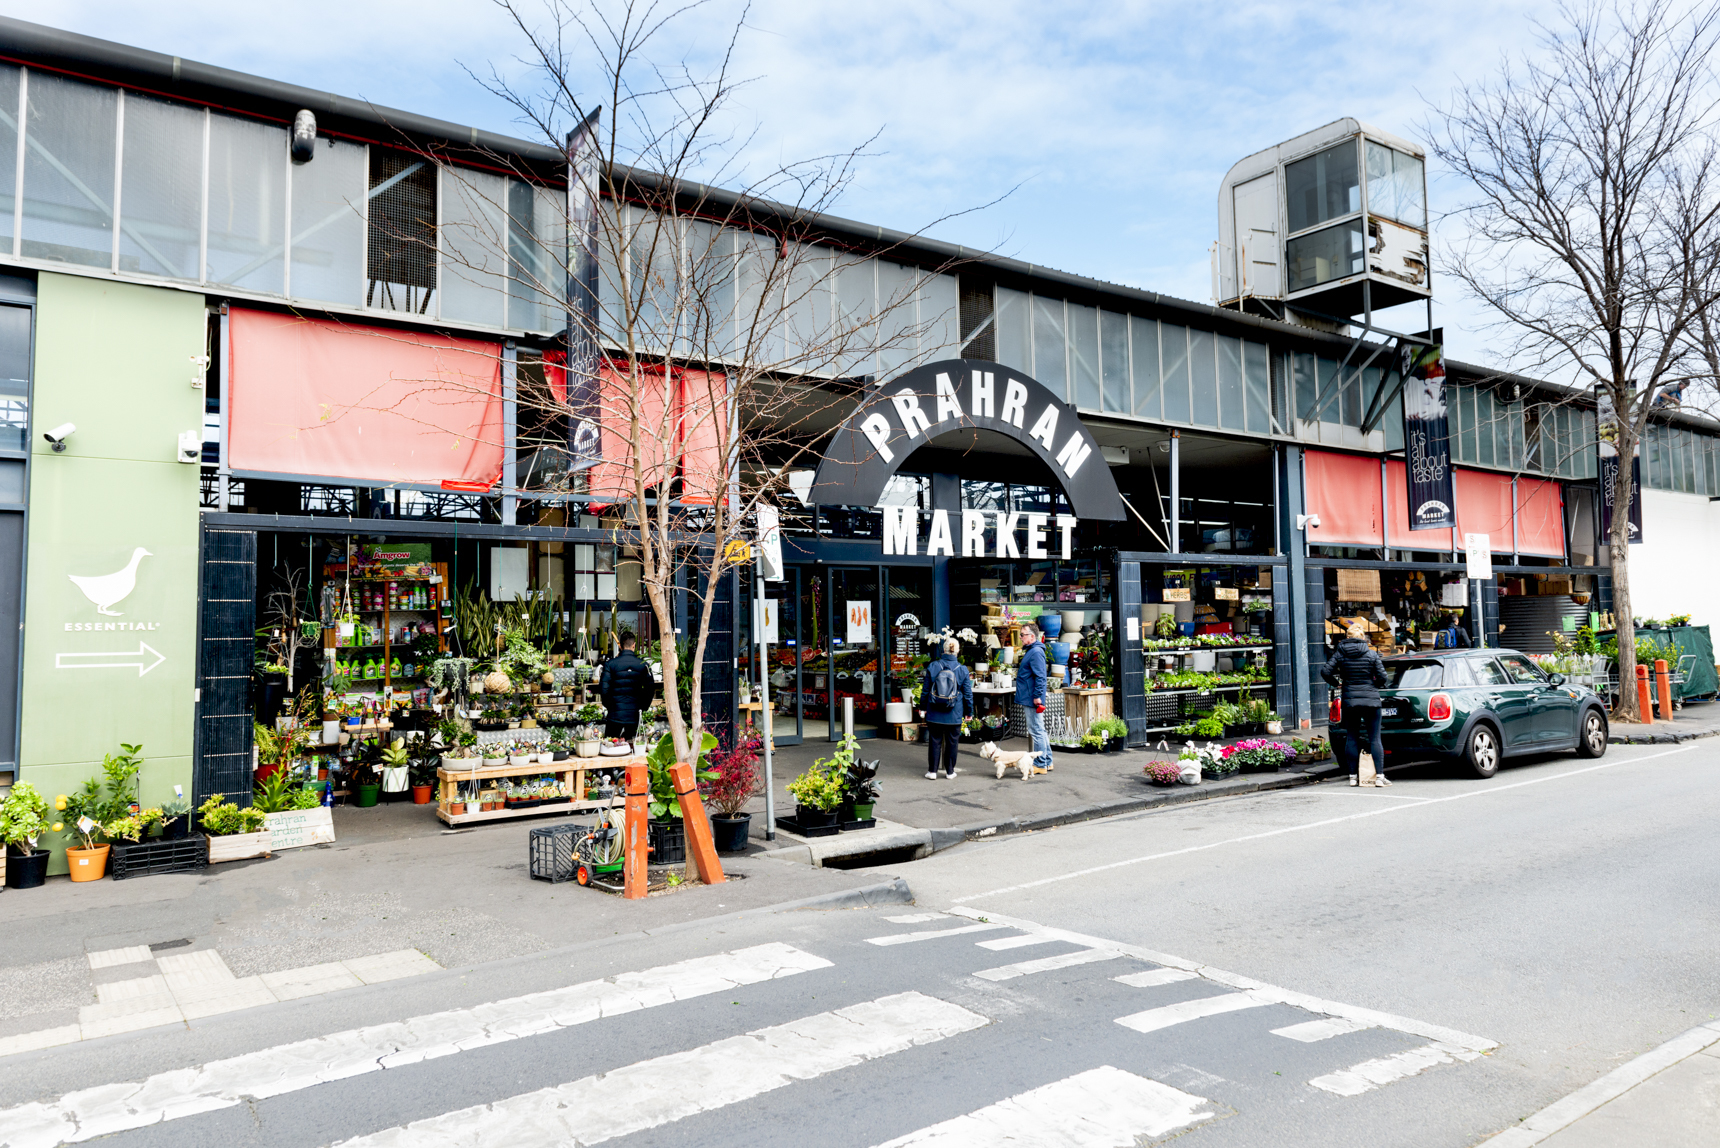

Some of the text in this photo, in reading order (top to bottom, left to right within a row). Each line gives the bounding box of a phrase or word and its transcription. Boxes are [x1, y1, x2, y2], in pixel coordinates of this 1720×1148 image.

[860, 370, 1092, 479] PRAHRAN
[1411, 429, 1426, 446] it's
[1412, 441, 1425, 459] all
[1412, 451, 1448, 471] about
[1412, 466, 1444, 483] taste
[1604, 462, 1619, 476] it's
[771, 534, 778, 545] P
[883, 506, 1077, 560] MARKET
[373, 552, 410, 561] Amgrow
[64, 622, 156, 632] ESSENTIAL
[269, 814, 307, 826] rahran
[270, 824, 303, 837] arden
[271, 837, 303, 848] entre
